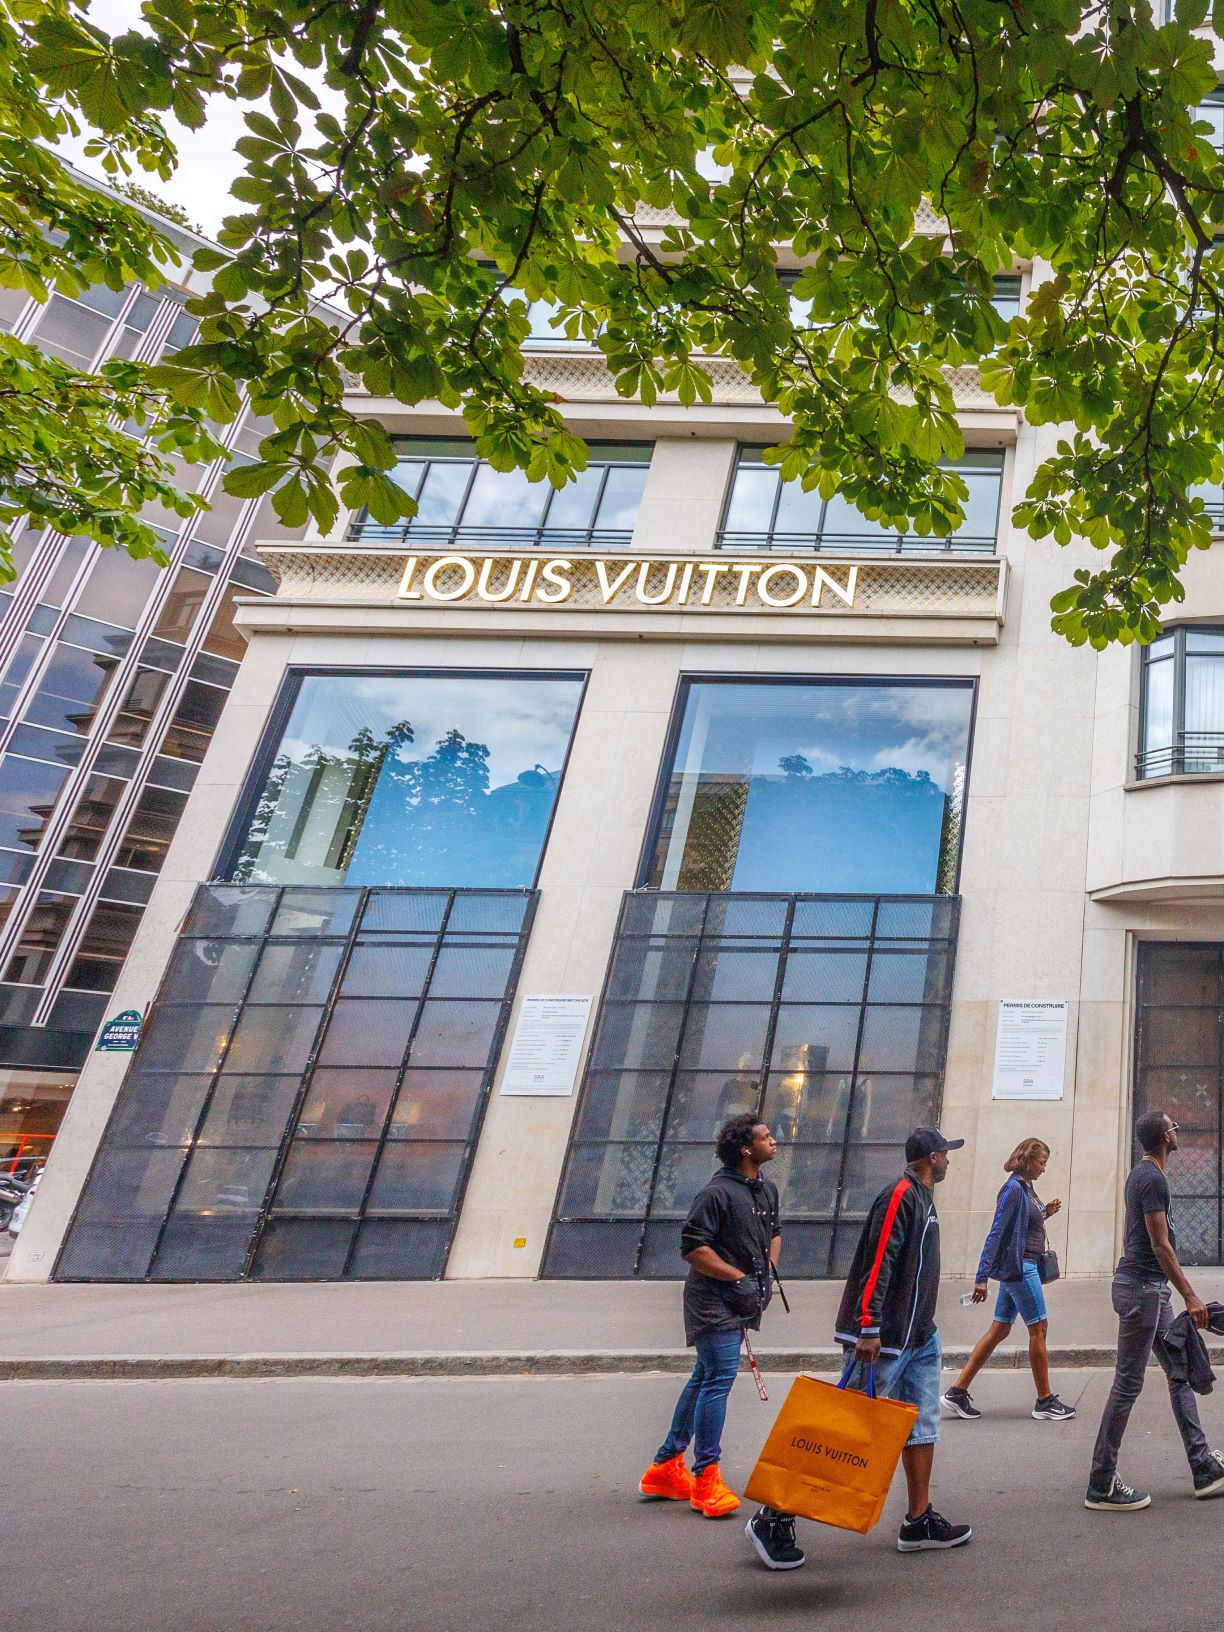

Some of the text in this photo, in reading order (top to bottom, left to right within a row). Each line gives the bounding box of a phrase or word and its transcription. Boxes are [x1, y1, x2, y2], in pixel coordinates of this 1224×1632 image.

[396, 556, 859, 608] LOUIS VUITTON
[791, 1436, 869, 1469] LOUIS VUITTON
